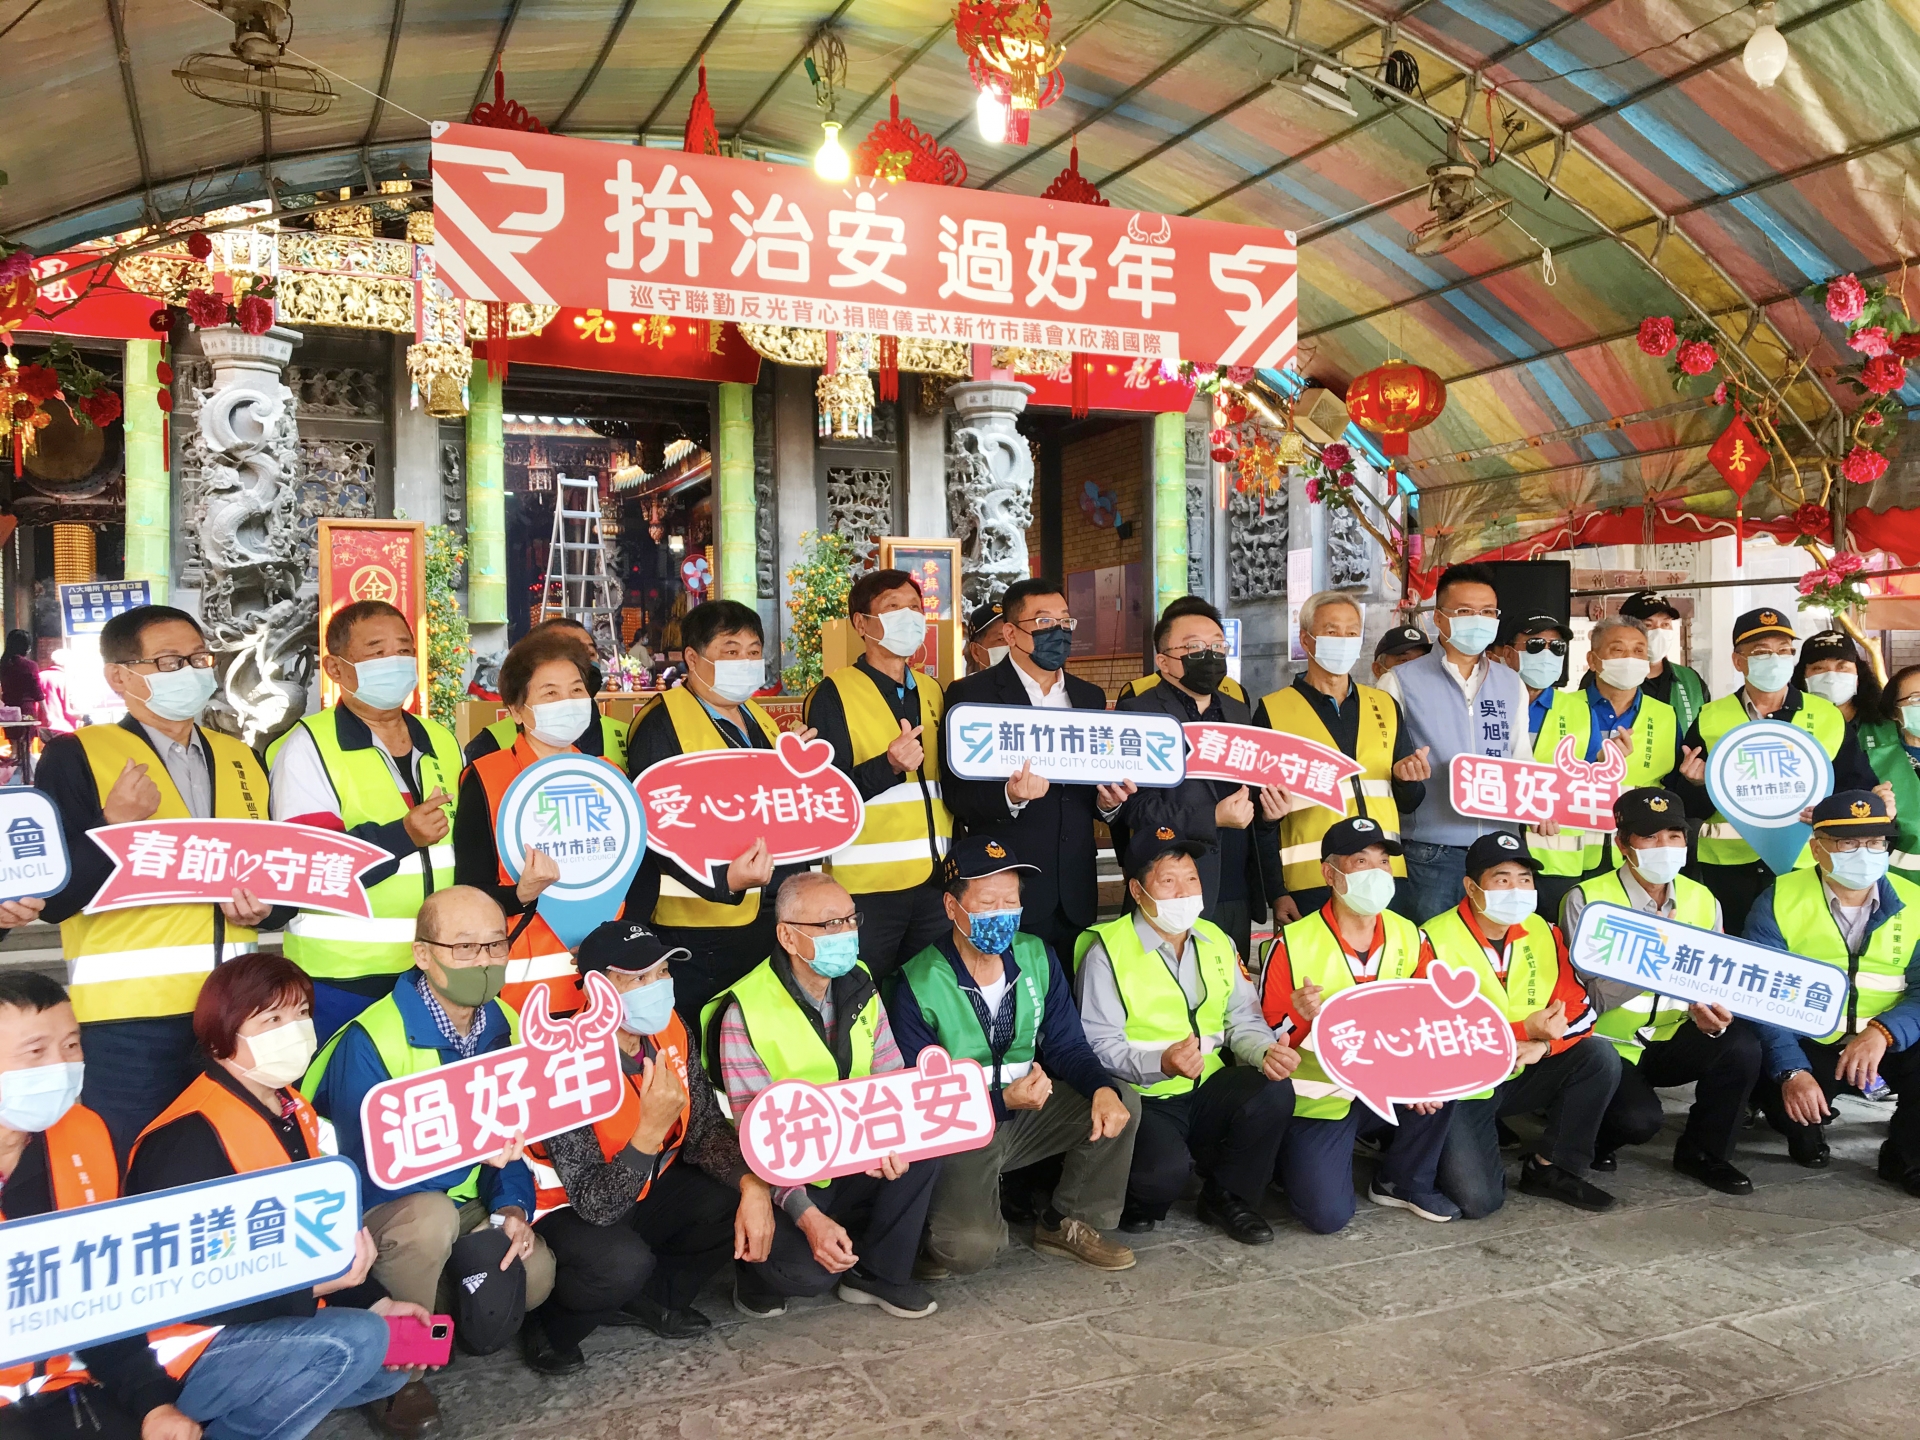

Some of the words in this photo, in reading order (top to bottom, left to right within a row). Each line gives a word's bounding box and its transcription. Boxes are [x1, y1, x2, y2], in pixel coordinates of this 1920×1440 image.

[604, 158, 908, 295] 拚治安
[938, 213, 1178, 320] 過好年
[629, 283, 1162, 356] 巡守聯勤反光背心捐贈儀式X新竹市議會X欣瀚國際
[1728, 438, 1748, 473] 春
[356, 571, 391, 601] 金
[998, 719, 1143, 759] 新竹市議會
[999, 753, 1057, 769] HSINCHU
[1060, 756, 1088, 770] CITY
[1090, 757, 1144, 772] COUNCIL
[1196, 727, 1340, 798] 春節守護
[648, 783, 850, 831] 愛心相挺
[1458, 764, 1614, 828] 過好年
[1735, 780, 1807, 798] 新竹市議會
[5, 816, 47, 860] 會
[126, 829, 357, 899] 春節守護
[534, 835, 617, 858] 新竹市議會
[1668, 972, 1729, 1000] HSINCHU
[1731, 988, 1764, 1010] CITY
[1765, 997, 1826, 1027] COUNCIL
[1670, 943, 1835, 1014] 新竹市議會
[1327, 1013, 1505, 1067] 愛心相挺
[380, 1040, 613, 1179] 過好年
[758, 1073, 979, 1171] 拚治安
[6, 1196, 289, 1313] 新竹市議會
[462, 1271, 488, 1285] adidas
[9, 1289, 124, 1337] HSINCHU
[131, 1274, 184, 1306] CITY
[190, 1251, 289, 1290] COUNCIL
